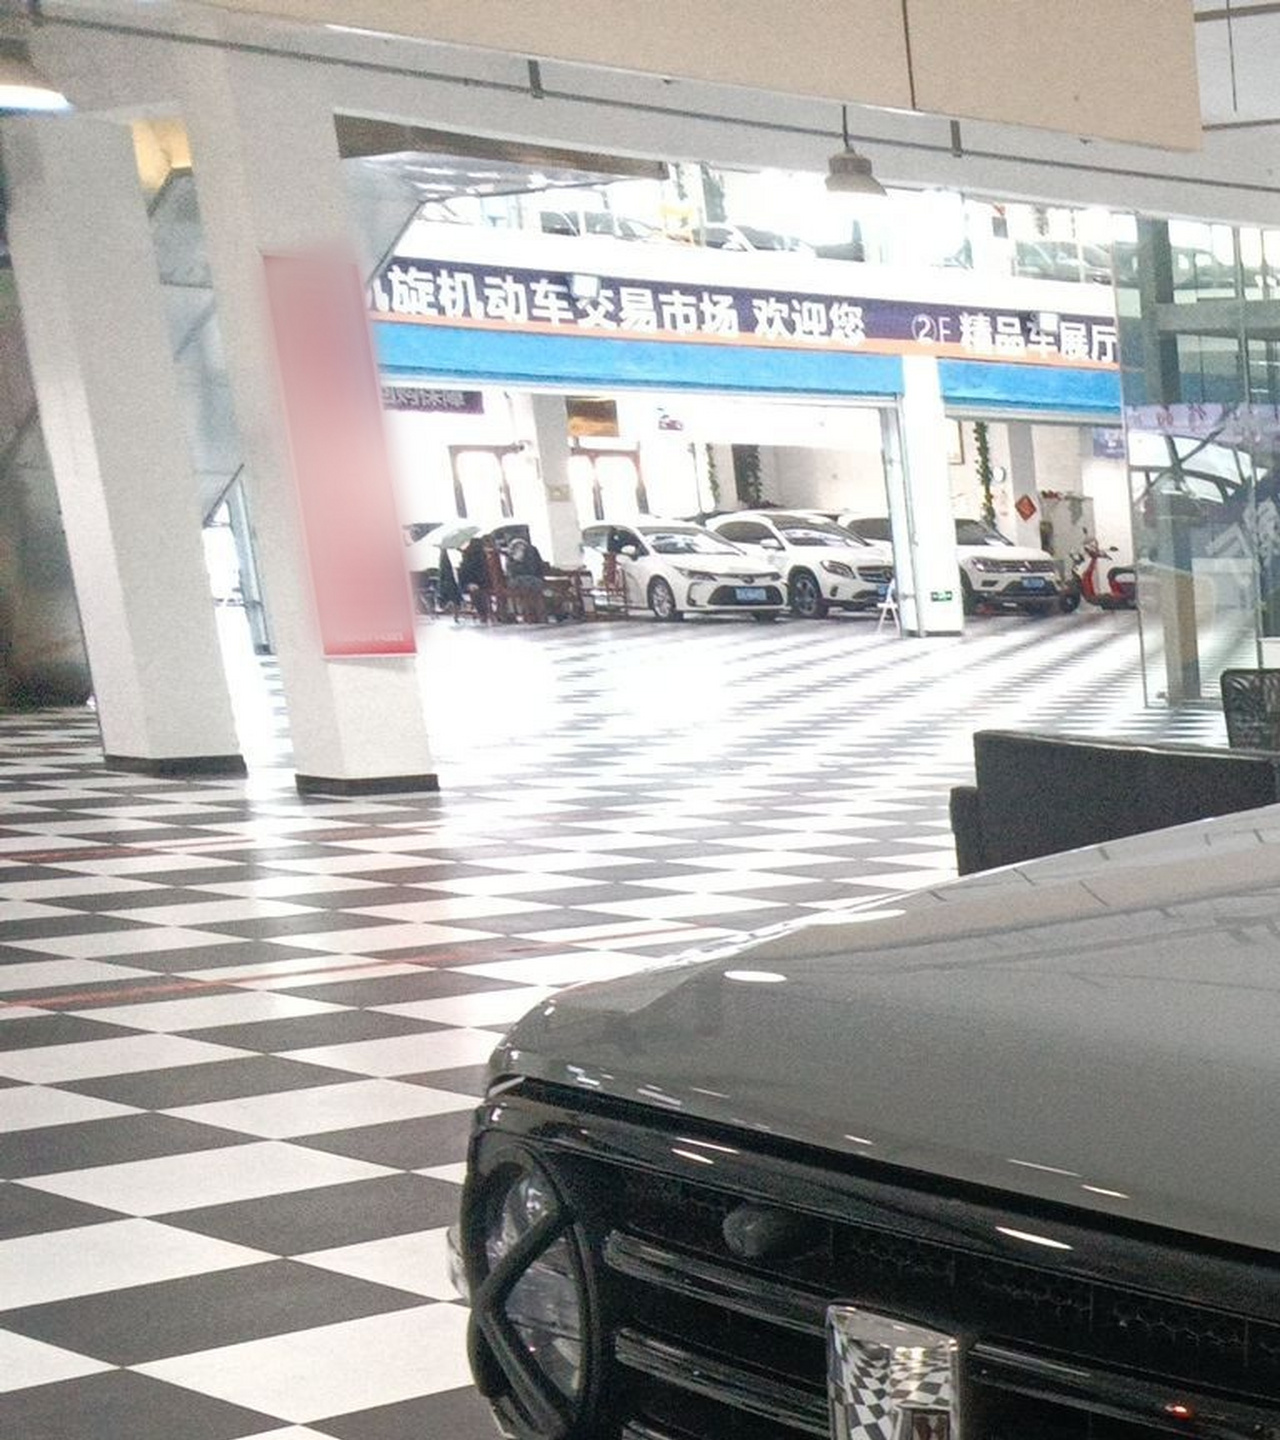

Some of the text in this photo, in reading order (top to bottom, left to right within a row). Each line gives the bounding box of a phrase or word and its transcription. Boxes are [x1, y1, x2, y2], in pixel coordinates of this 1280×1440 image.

[752, 296, 867, 347] 欢迎您
[959, 311, 1119, 363] 精品车展厅
